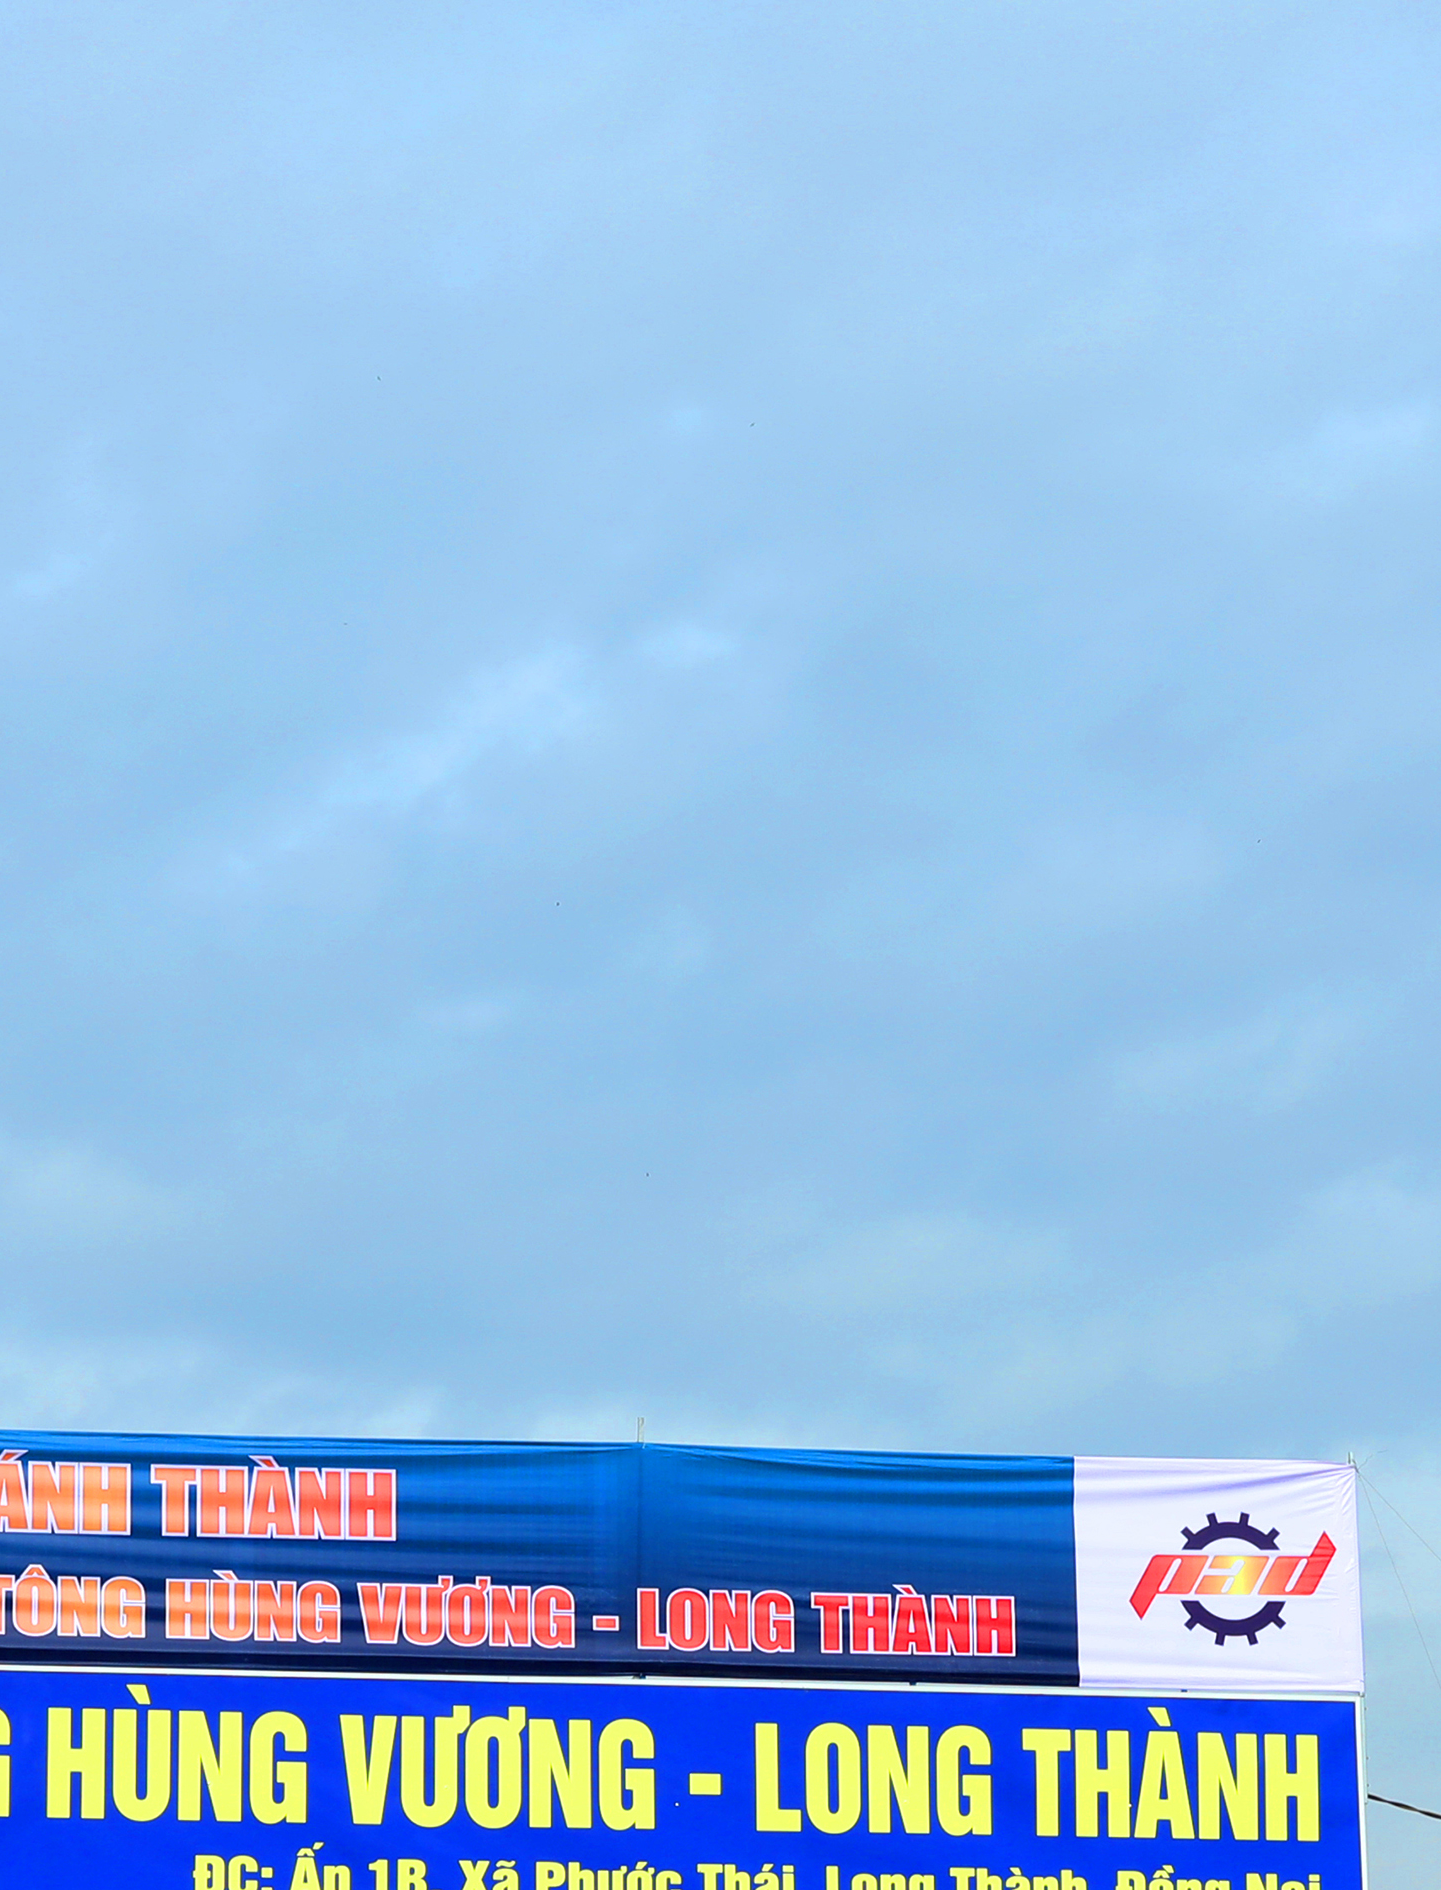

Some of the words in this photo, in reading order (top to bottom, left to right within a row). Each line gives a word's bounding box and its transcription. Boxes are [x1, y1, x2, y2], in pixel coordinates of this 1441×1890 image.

[150, 1455, 398, 1542] THÀNH
[165, 1570, 342, 1643] HÙNG
[358, 1575, 575, 1650] VƯƠNG
[637, 1588, 795, 1655] LONG
[812, 1584, 1016, 1658] THÀNH
[46, 1684, 308, 1825] HÙNG
[340, 1703, 656, 1831] VƯƠNG
[756, 1722, 992, 1837] LONG
[1023, 1707, 1320, 1842] THÀNH
